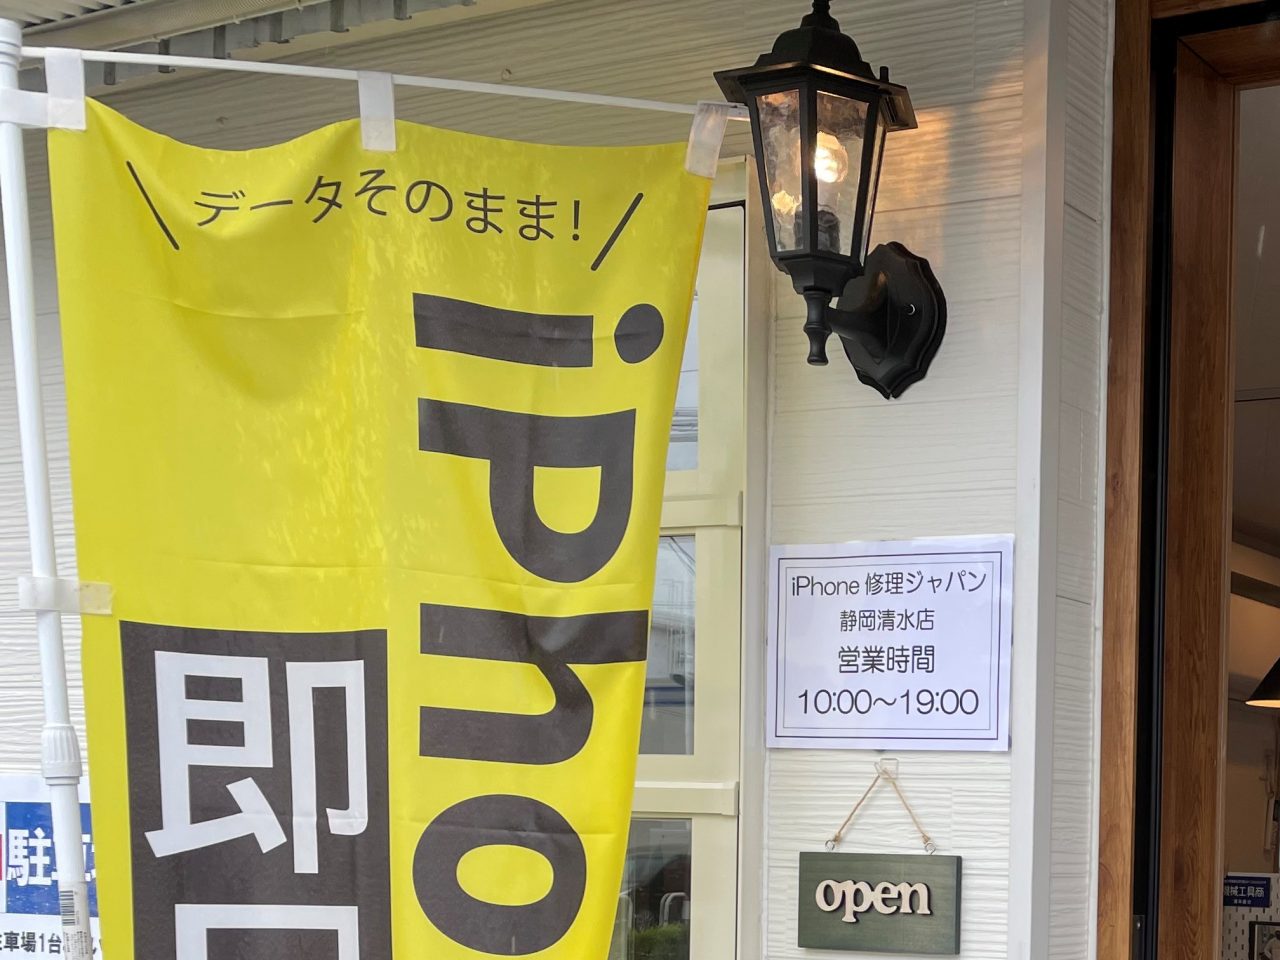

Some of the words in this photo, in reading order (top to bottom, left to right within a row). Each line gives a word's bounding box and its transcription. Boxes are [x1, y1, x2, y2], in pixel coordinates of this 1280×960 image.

[791, 576, 860, 596] iPhone
[865, 570, 987, 595] 修理ジャパン
[839, 608, 935, 632] 静岡清水店
[837, 645, 935, 674] 営業時間
[815, 878, 931, 922] open
